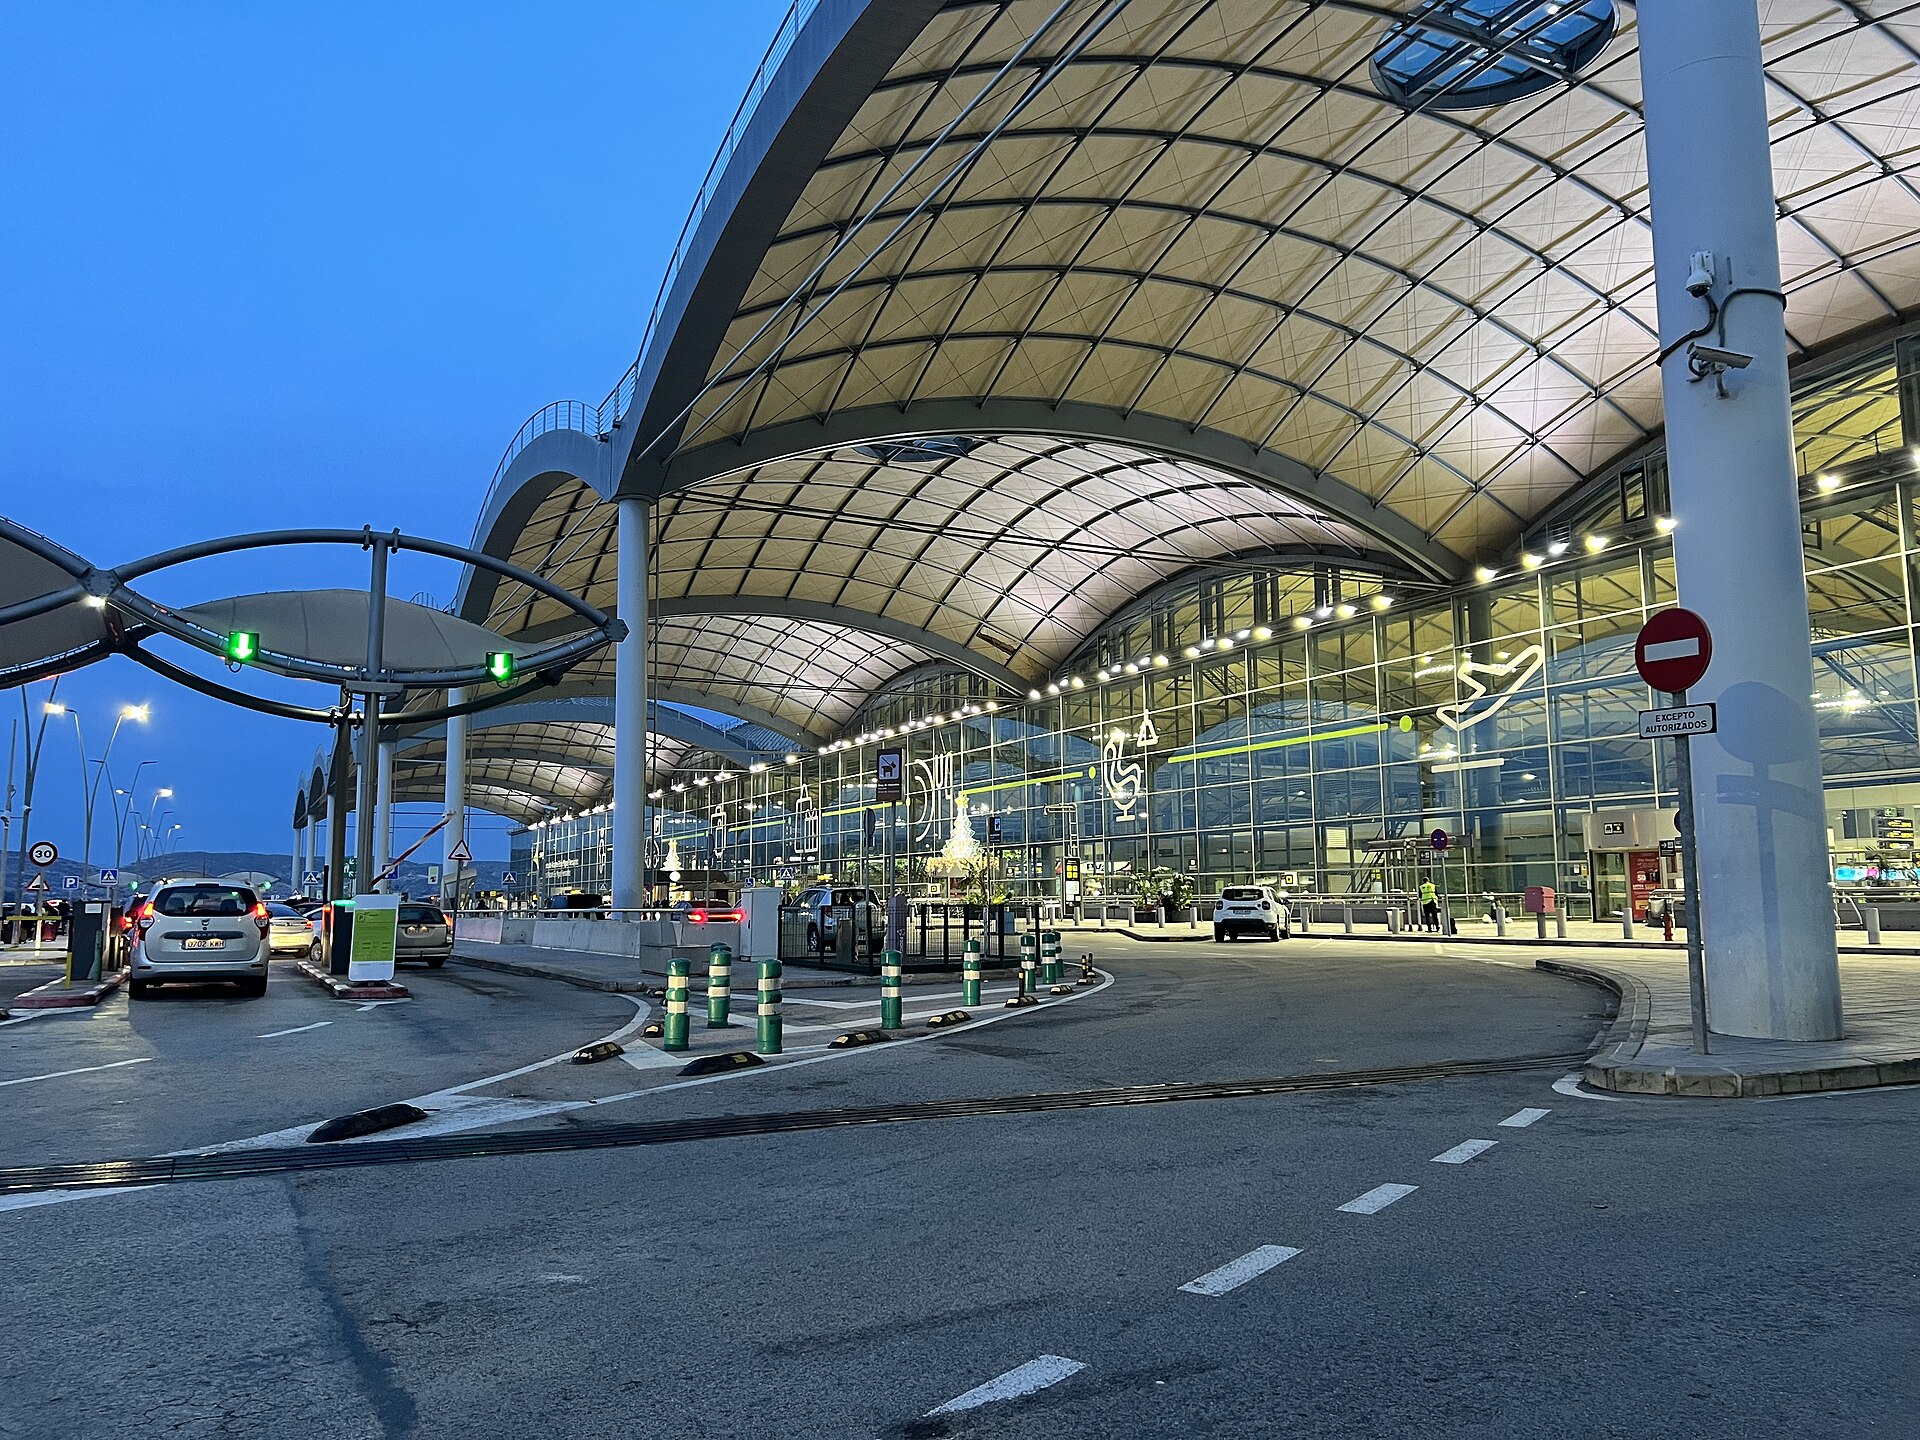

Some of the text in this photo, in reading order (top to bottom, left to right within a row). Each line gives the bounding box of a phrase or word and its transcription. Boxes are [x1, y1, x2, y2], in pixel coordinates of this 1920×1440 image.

[1655, 711, 1695, 722] EXCEPTO
[1645, 720, 1707, 733] AUTORIZADOS
[35, 850, 52, 858] 30
[66, 878, 76, 888] P
